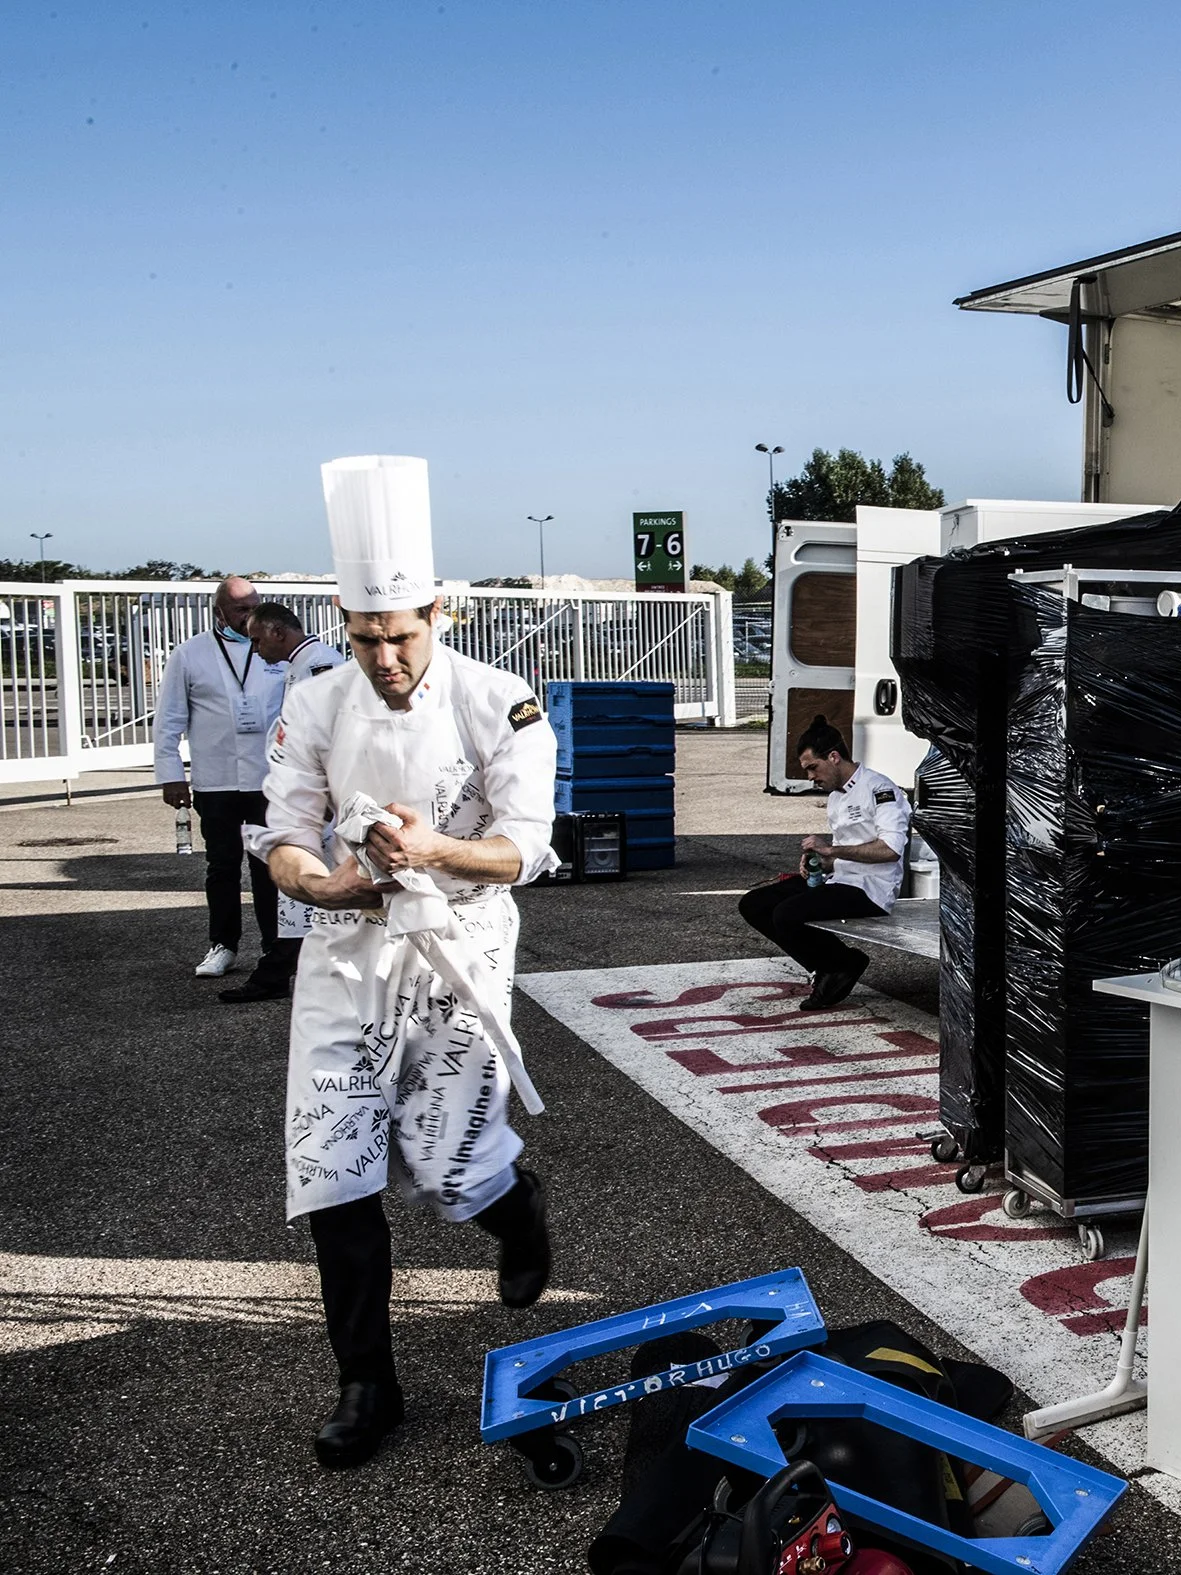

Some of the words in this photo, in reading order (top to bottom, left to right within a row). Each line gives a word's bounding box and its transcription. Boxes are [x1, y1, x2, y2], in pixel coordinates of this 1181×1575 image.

[640, 517, 677, 526] PARKINGS
[637, 534, 650, 556] 7
[667, 533, 682, 555] 6
[312, 1076, 381, 1093] VALRHO
[320, 1105, 370, 1151] VALRHONA
[551, 1369, 686, 1422] VICTOR
[696, 1344, 771, 1378] HUGO
